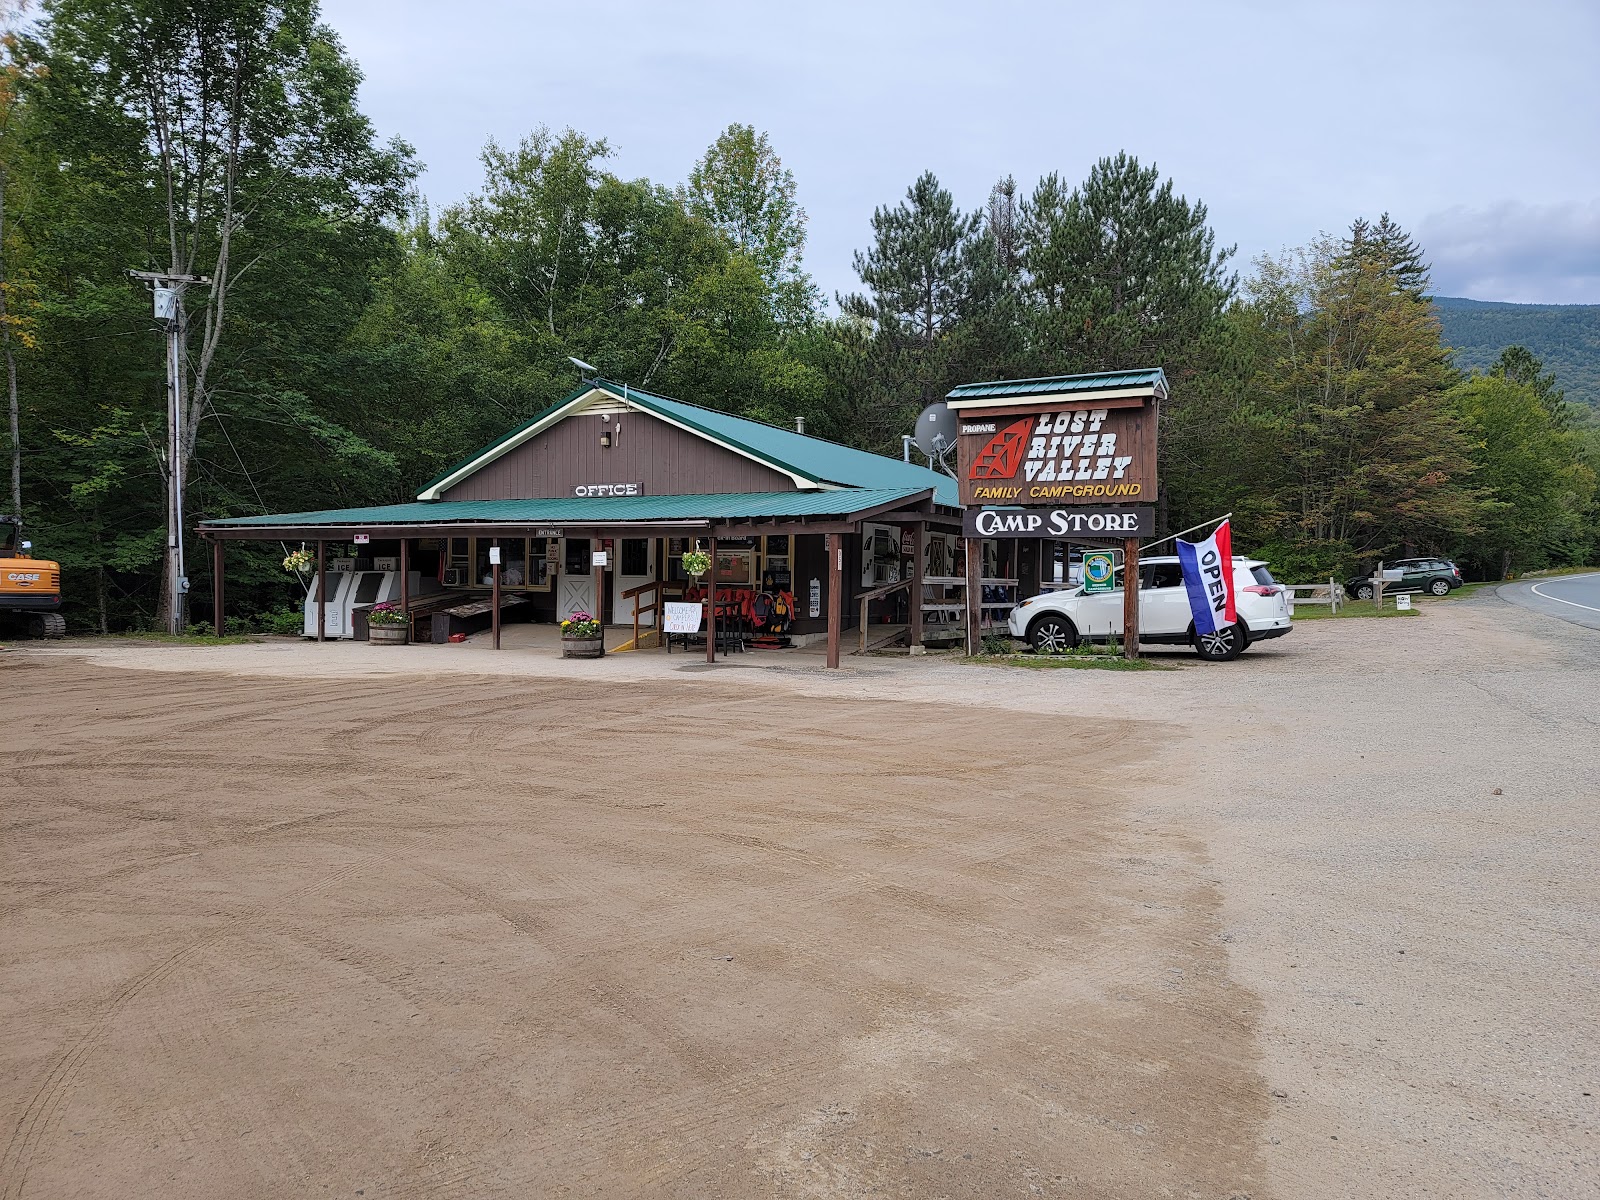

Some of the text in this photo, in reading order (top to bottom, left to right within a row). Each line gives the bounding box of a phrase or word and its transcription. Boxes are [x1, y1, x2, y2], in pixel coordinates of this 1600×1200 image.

[962, 424, 996, 433] PROPANE
[1034, 409, 1109, 435] LOST
[1027, 433, 1118, 459] RIVER
[1023, 456, 1133, 482] VALLEY
[575, 483, 638, 497] OFFICE
[974, 483, 1141, 499] FAMILY CAMPGROUND
[7, 573, 40, 581] CASE
[1201, 550, 1226, 613] OPEN
